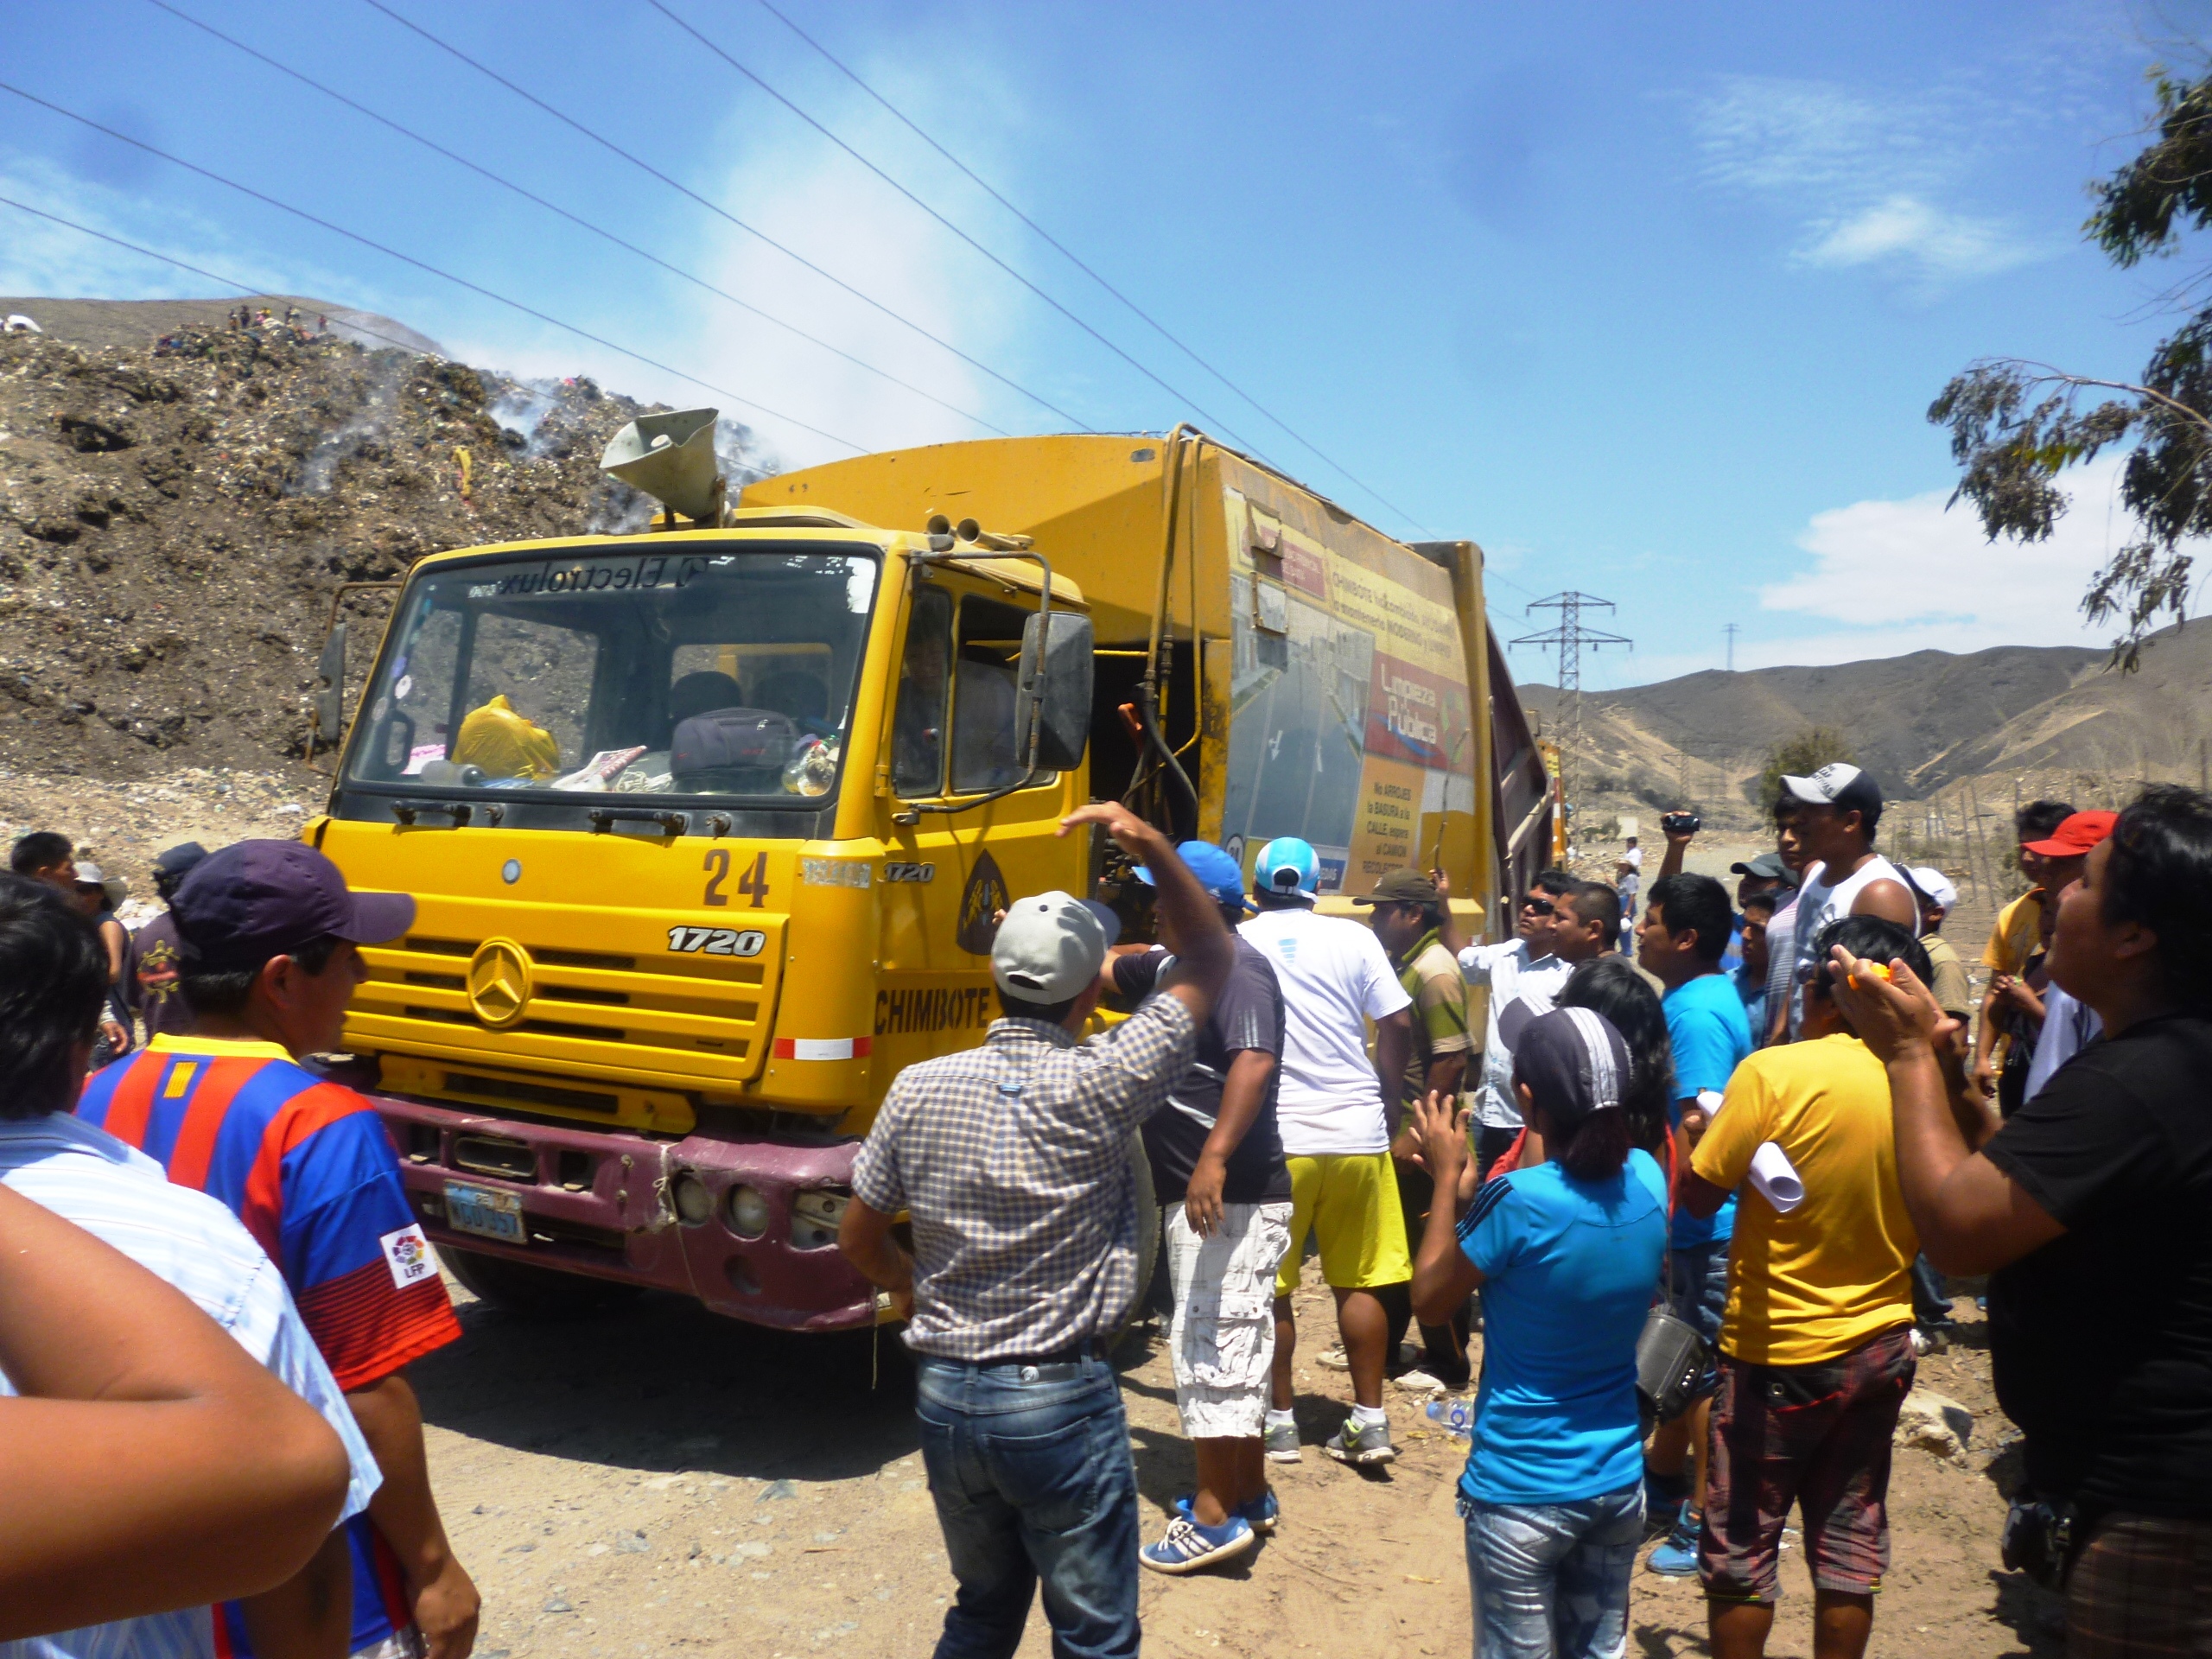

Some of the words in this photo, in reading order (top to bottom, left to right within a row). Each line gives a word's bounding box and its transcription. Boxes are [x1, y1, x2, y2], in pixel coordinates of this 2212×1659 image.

[702, 849, 770, 908] 24
[884, 861, 935, 882] 1720
[668, 925, 766, 957] 1720
[874, 988, 991, 1035] CHIMBOTE
[404, 1263, 425, 1279] LFP
